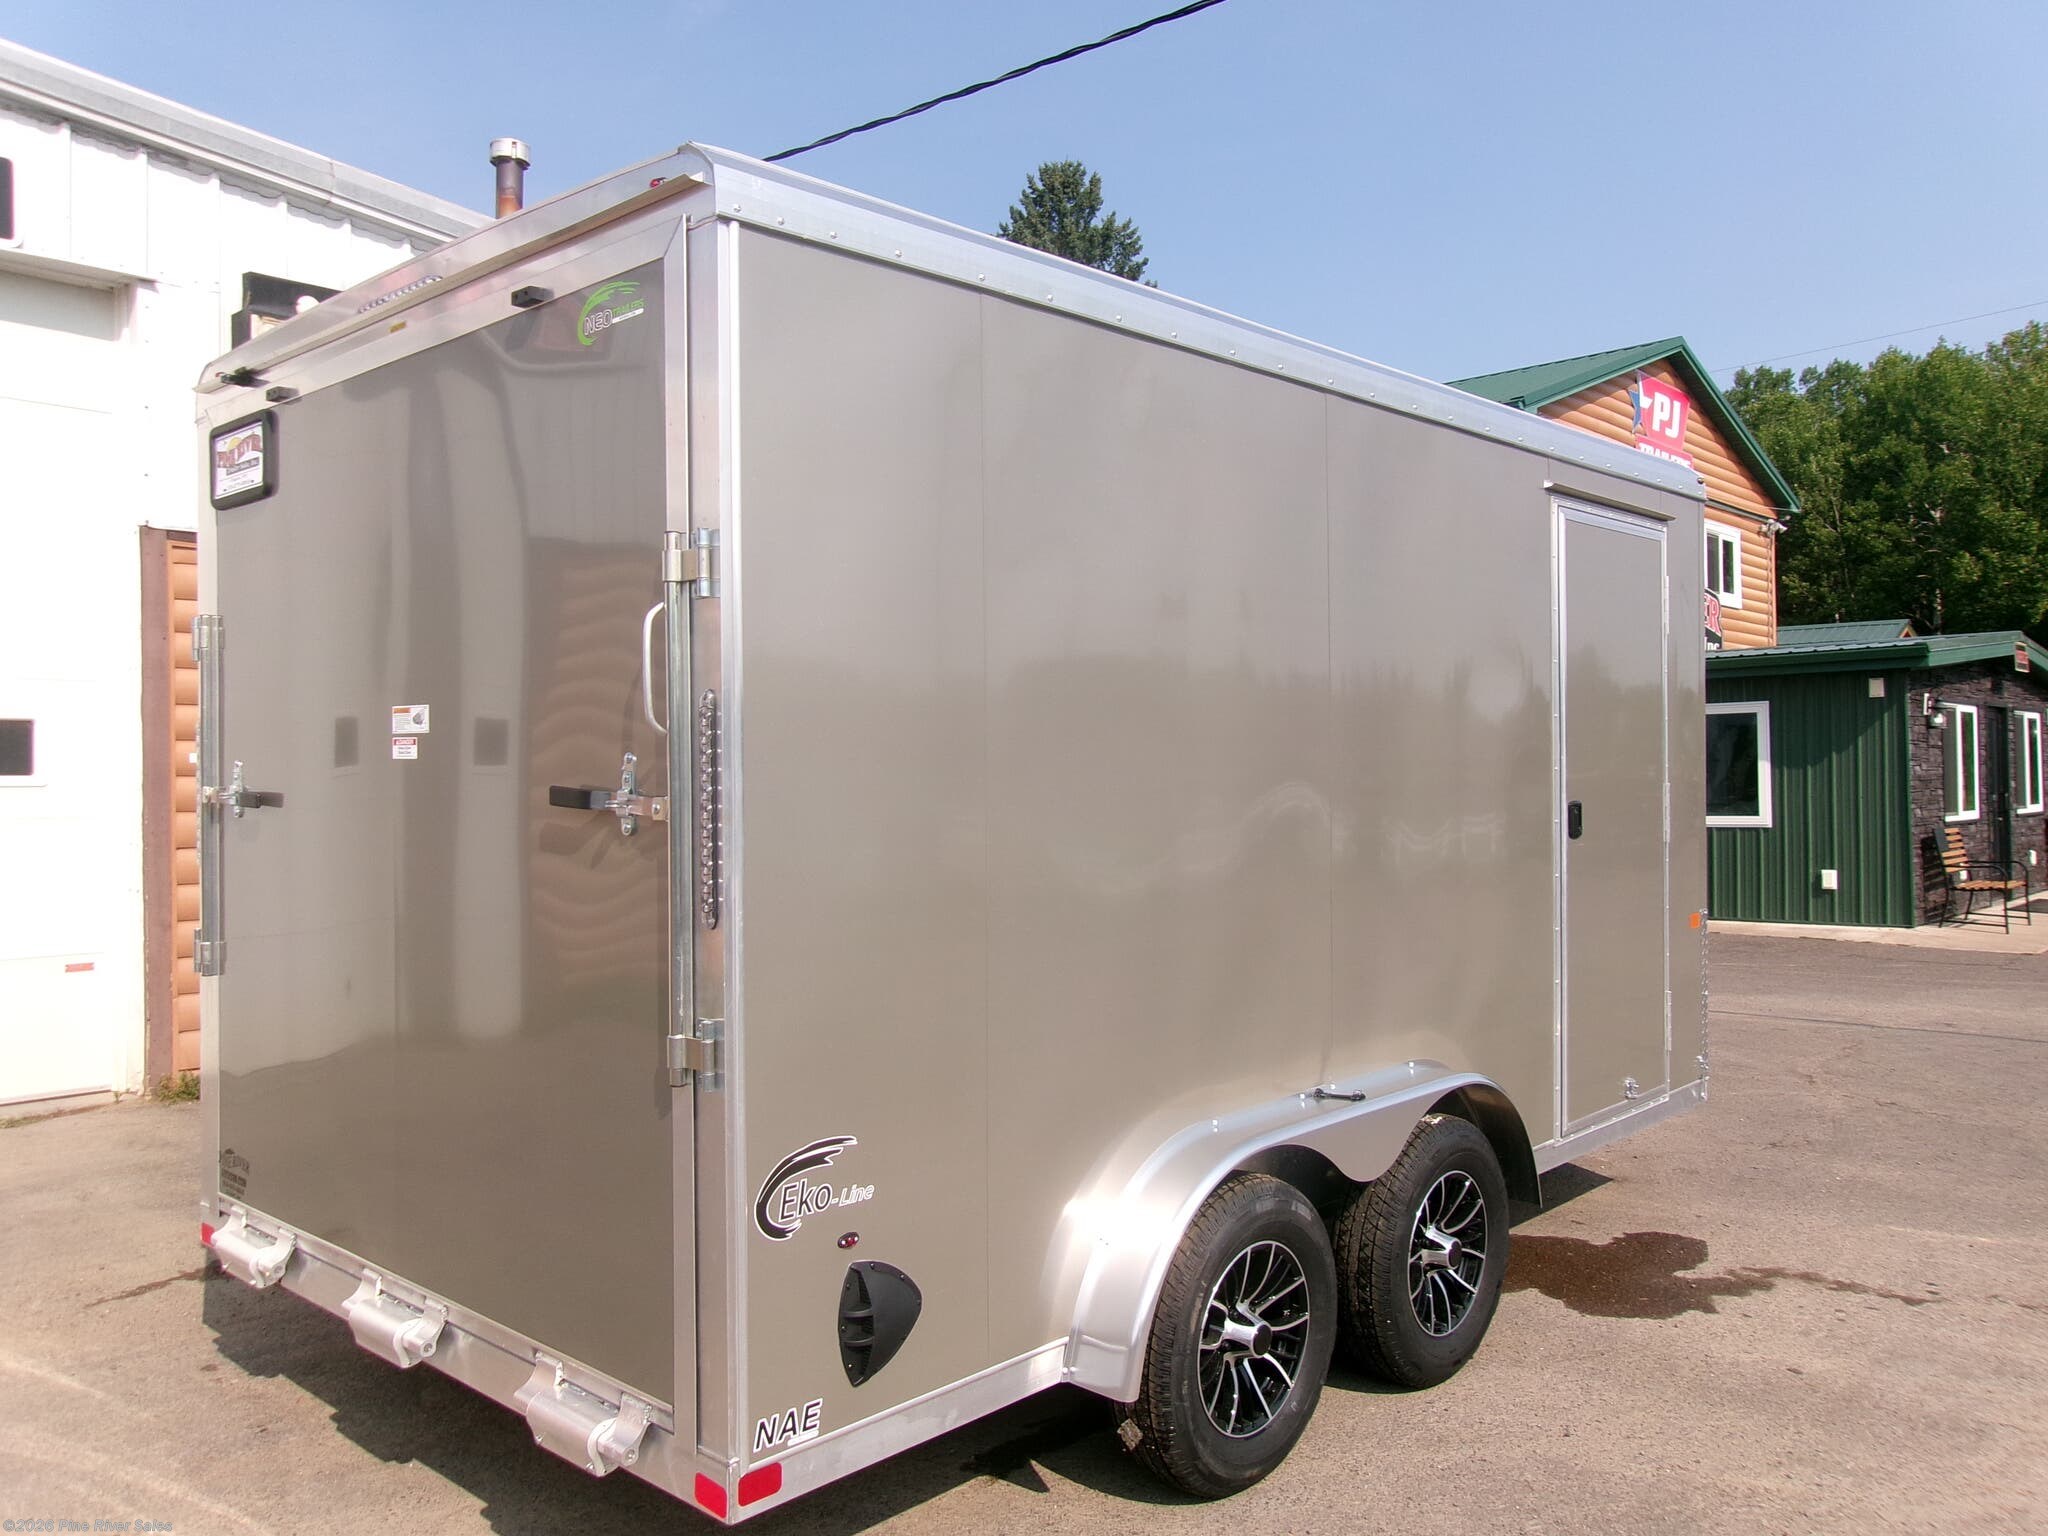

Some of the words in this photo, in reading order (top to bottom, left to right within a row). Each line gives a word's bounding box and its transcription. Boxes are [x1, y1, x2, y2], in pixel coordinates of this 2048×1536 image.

[583, 308, 613, 336] NEO
[1652, 391, 1682, 439] PJ
[753, 1398, 823, 1453] NAE
